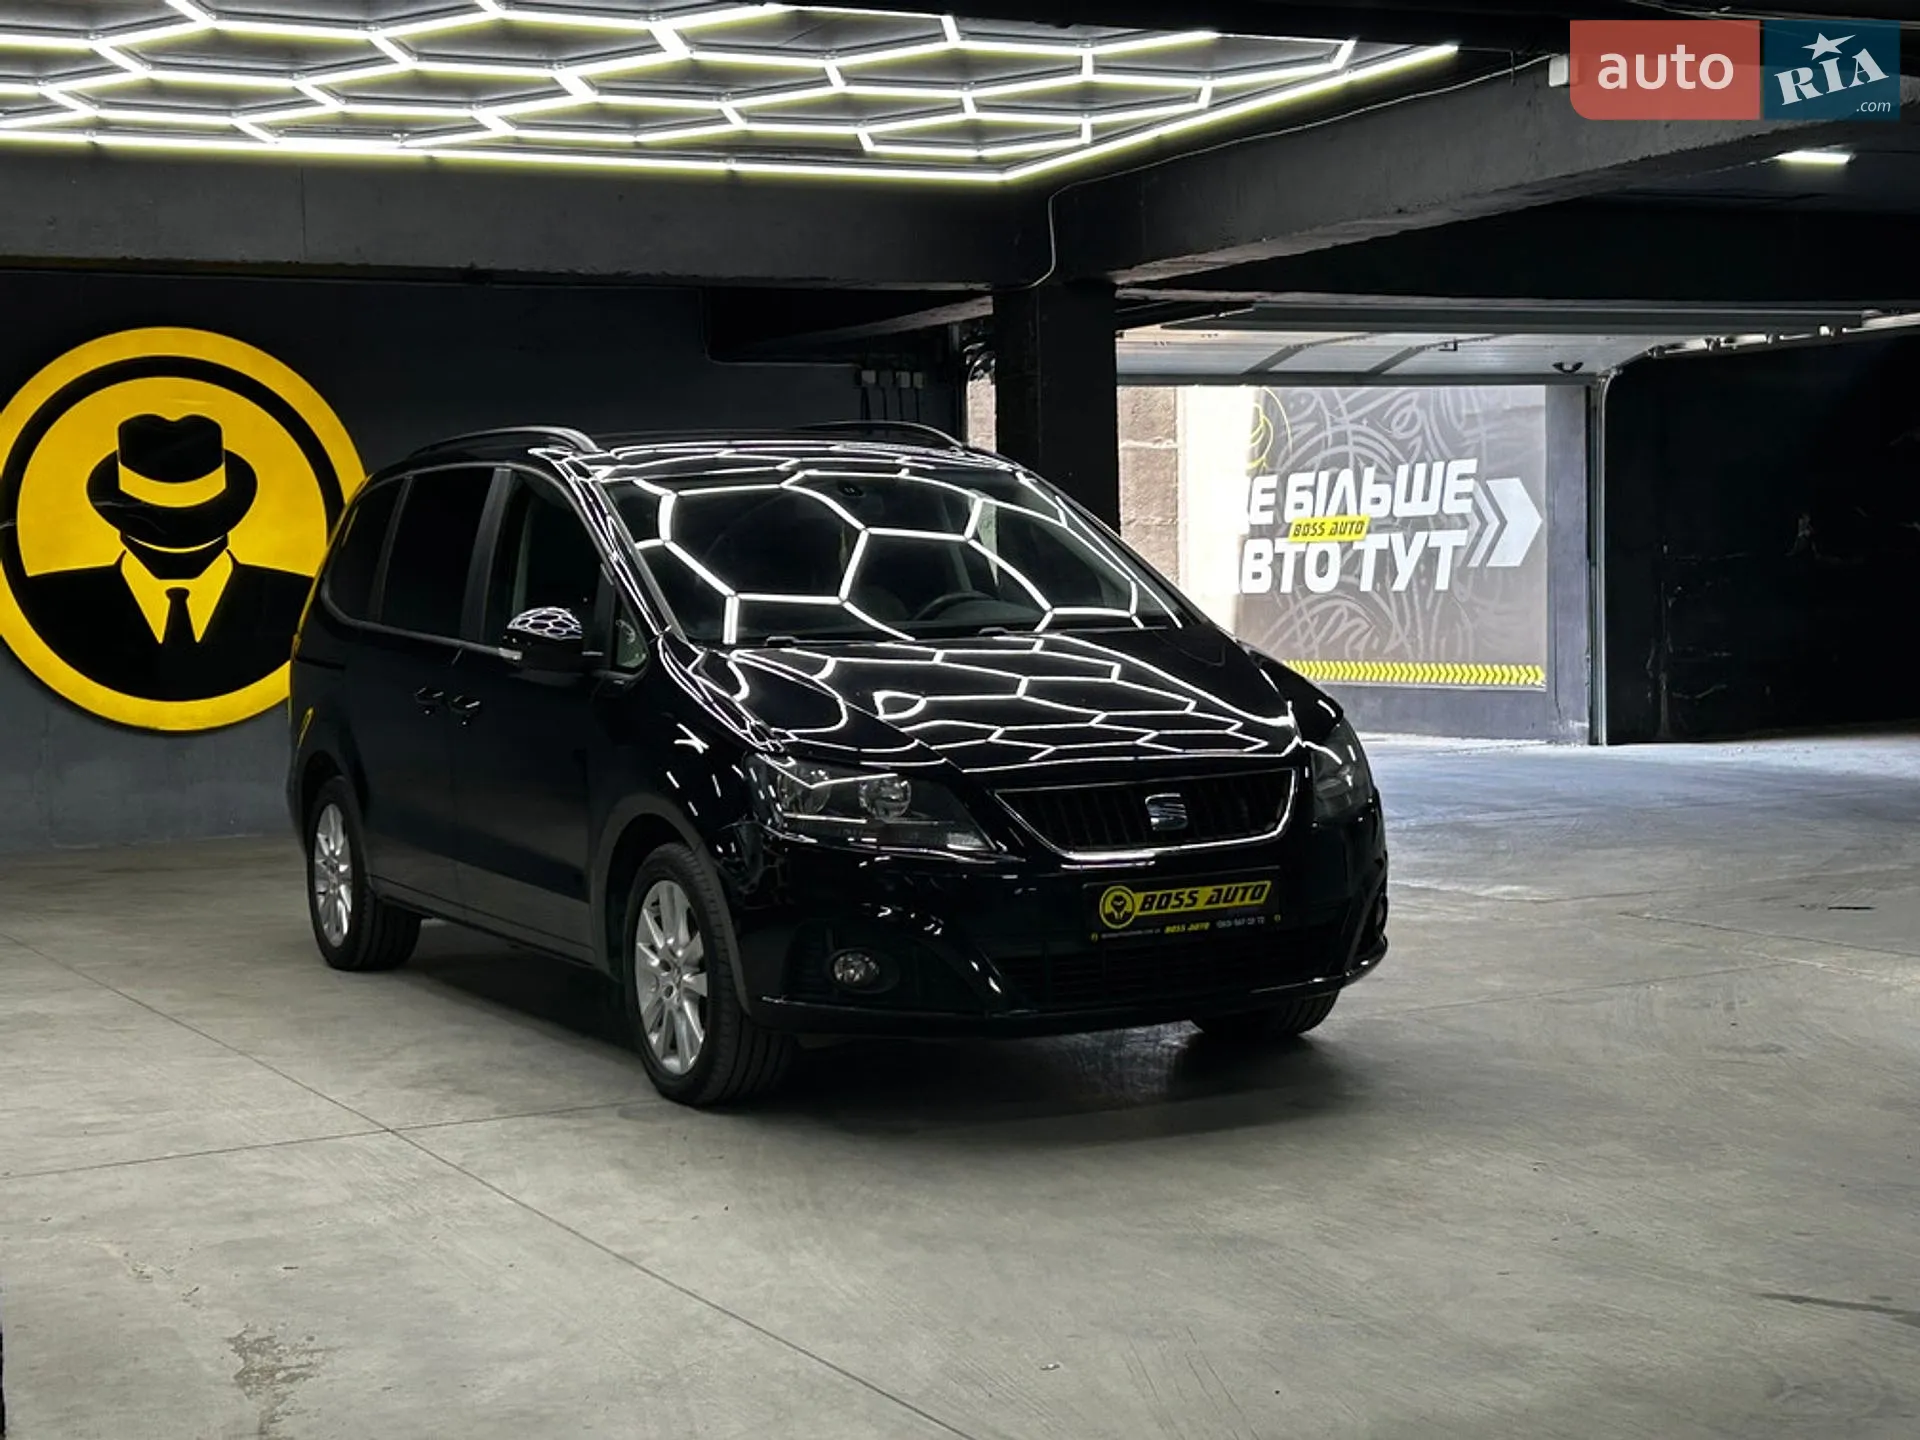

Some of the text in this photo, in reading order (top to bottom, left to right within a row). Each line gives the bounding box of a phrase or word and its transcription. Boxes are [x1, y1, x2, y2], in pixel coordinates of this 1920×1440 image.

[1248, 458, 1478, 526] Е БІЛЬШЕ
[1293, 521, 1326, 537] BOSS
[1241, 529, 1468, 594] ВТО ТУТ
[1139, 889, 1199, 912] BOSS
